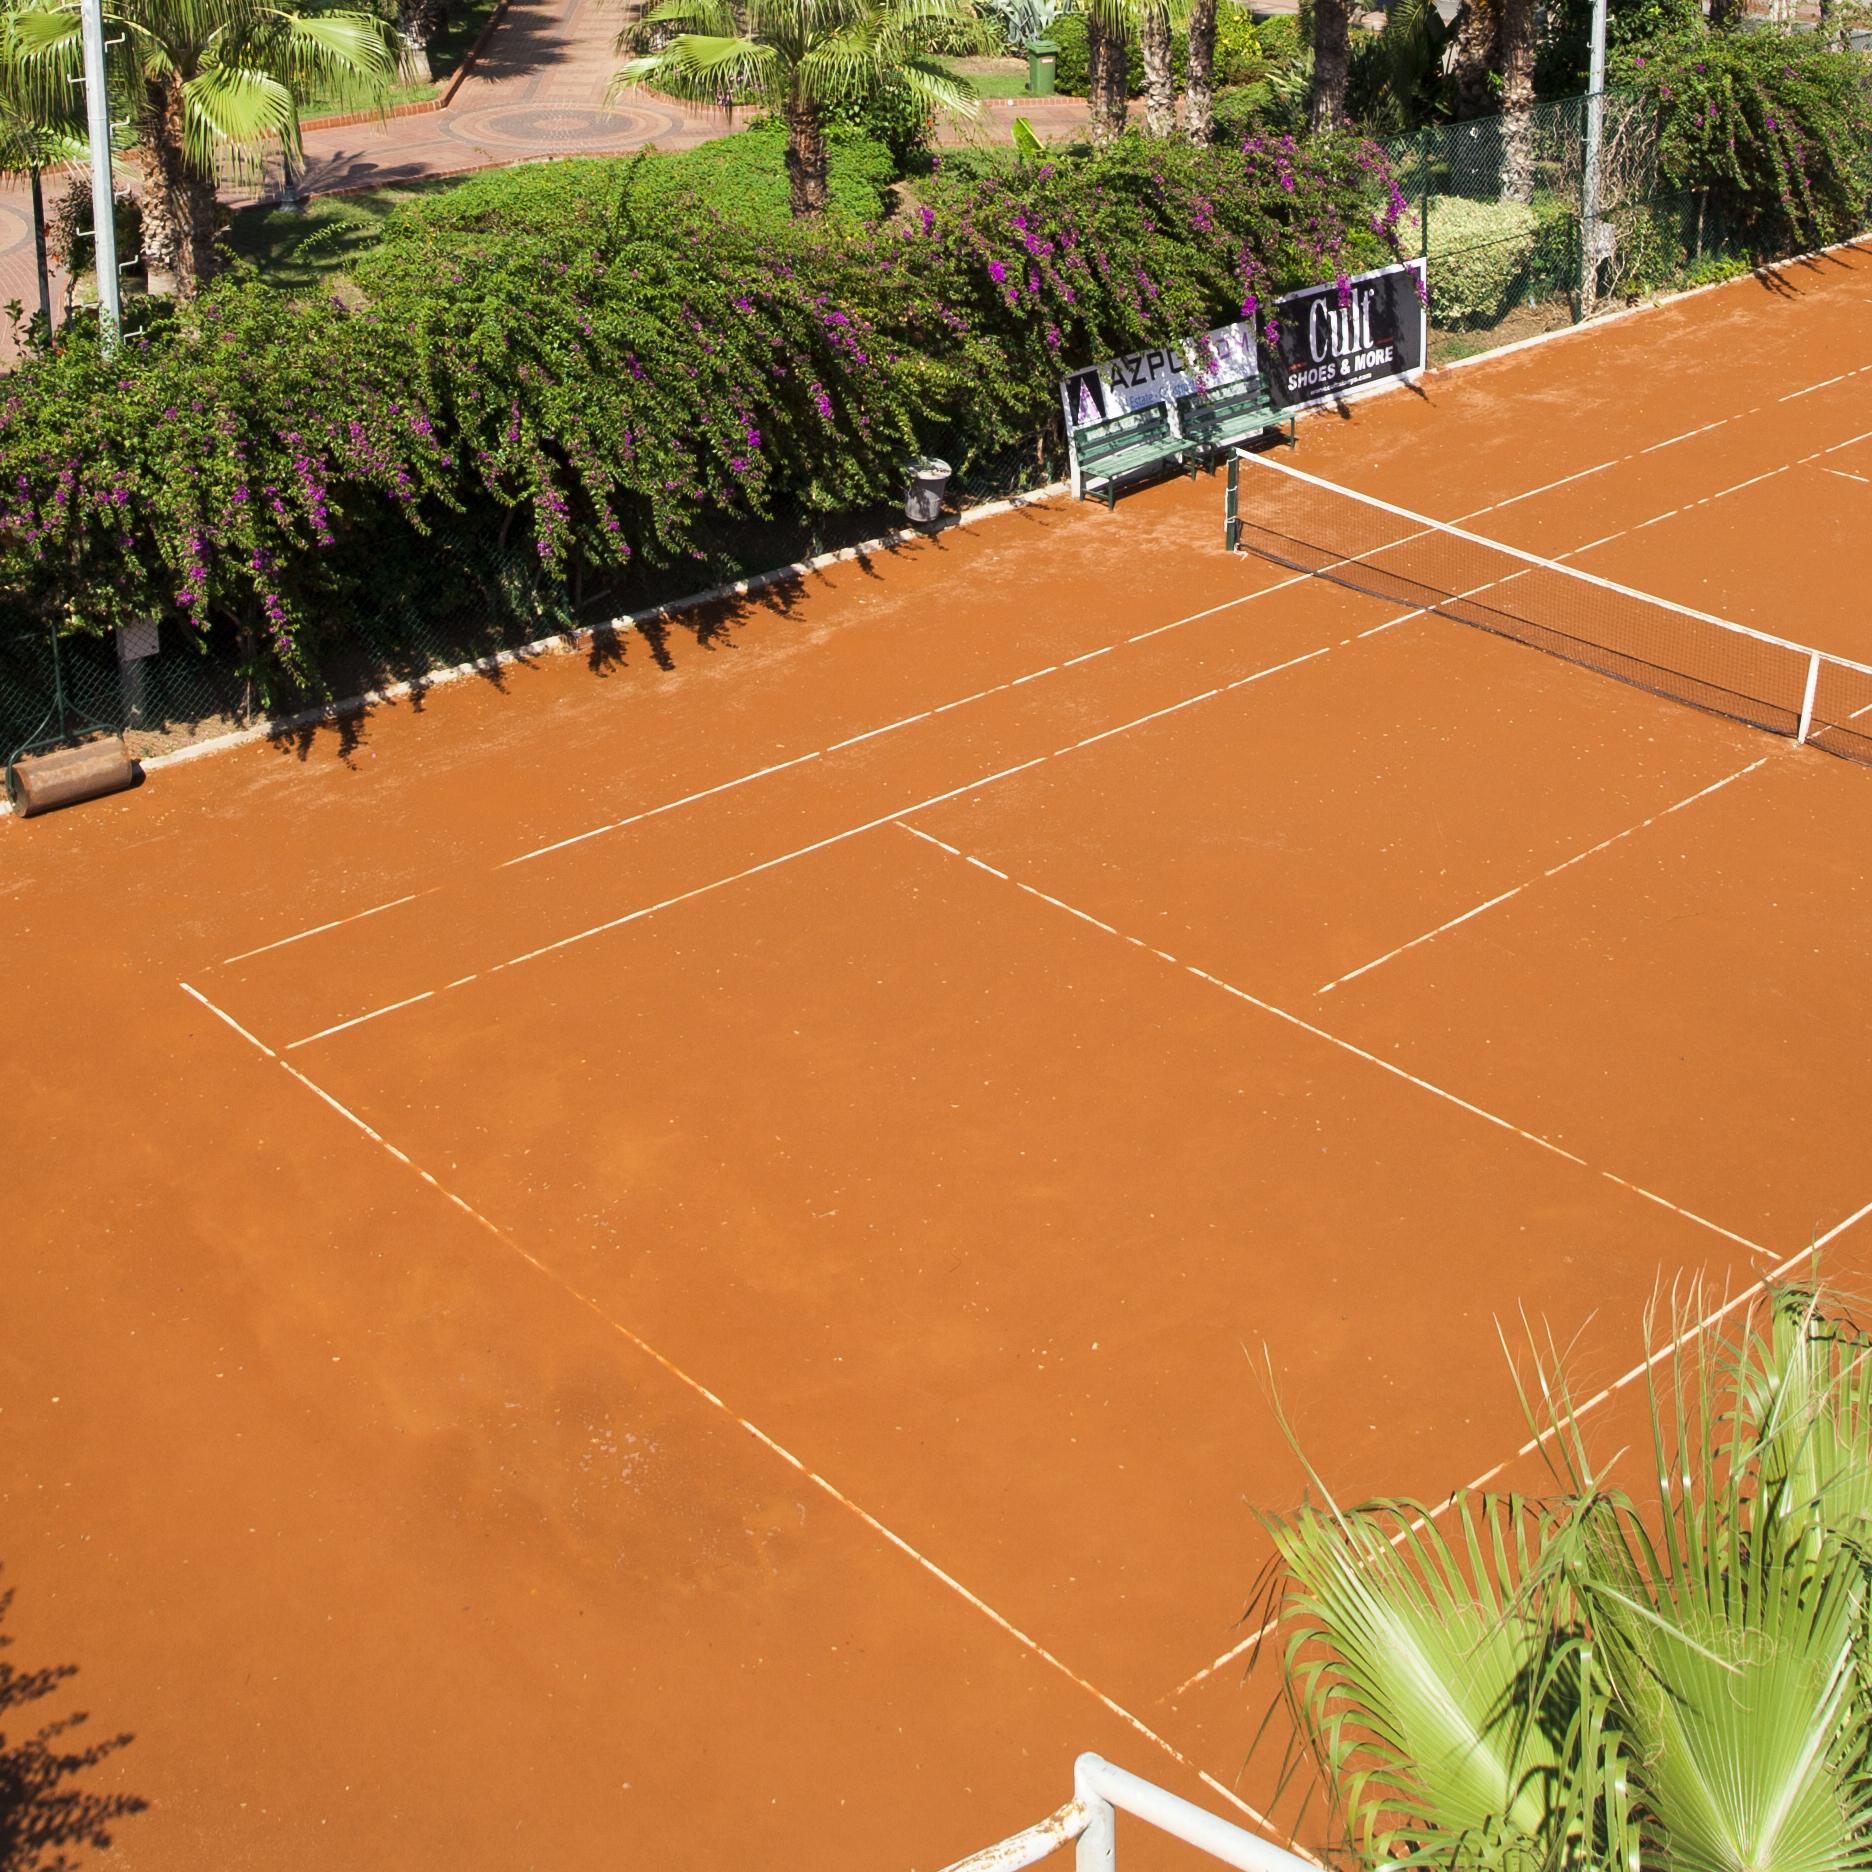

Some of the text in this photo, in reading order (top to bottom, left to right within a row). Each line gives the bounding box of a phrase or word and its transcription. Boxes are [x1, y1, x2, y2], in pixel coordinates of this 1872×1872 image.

[1288, 345, 1394, 391] SHOES & MORE
